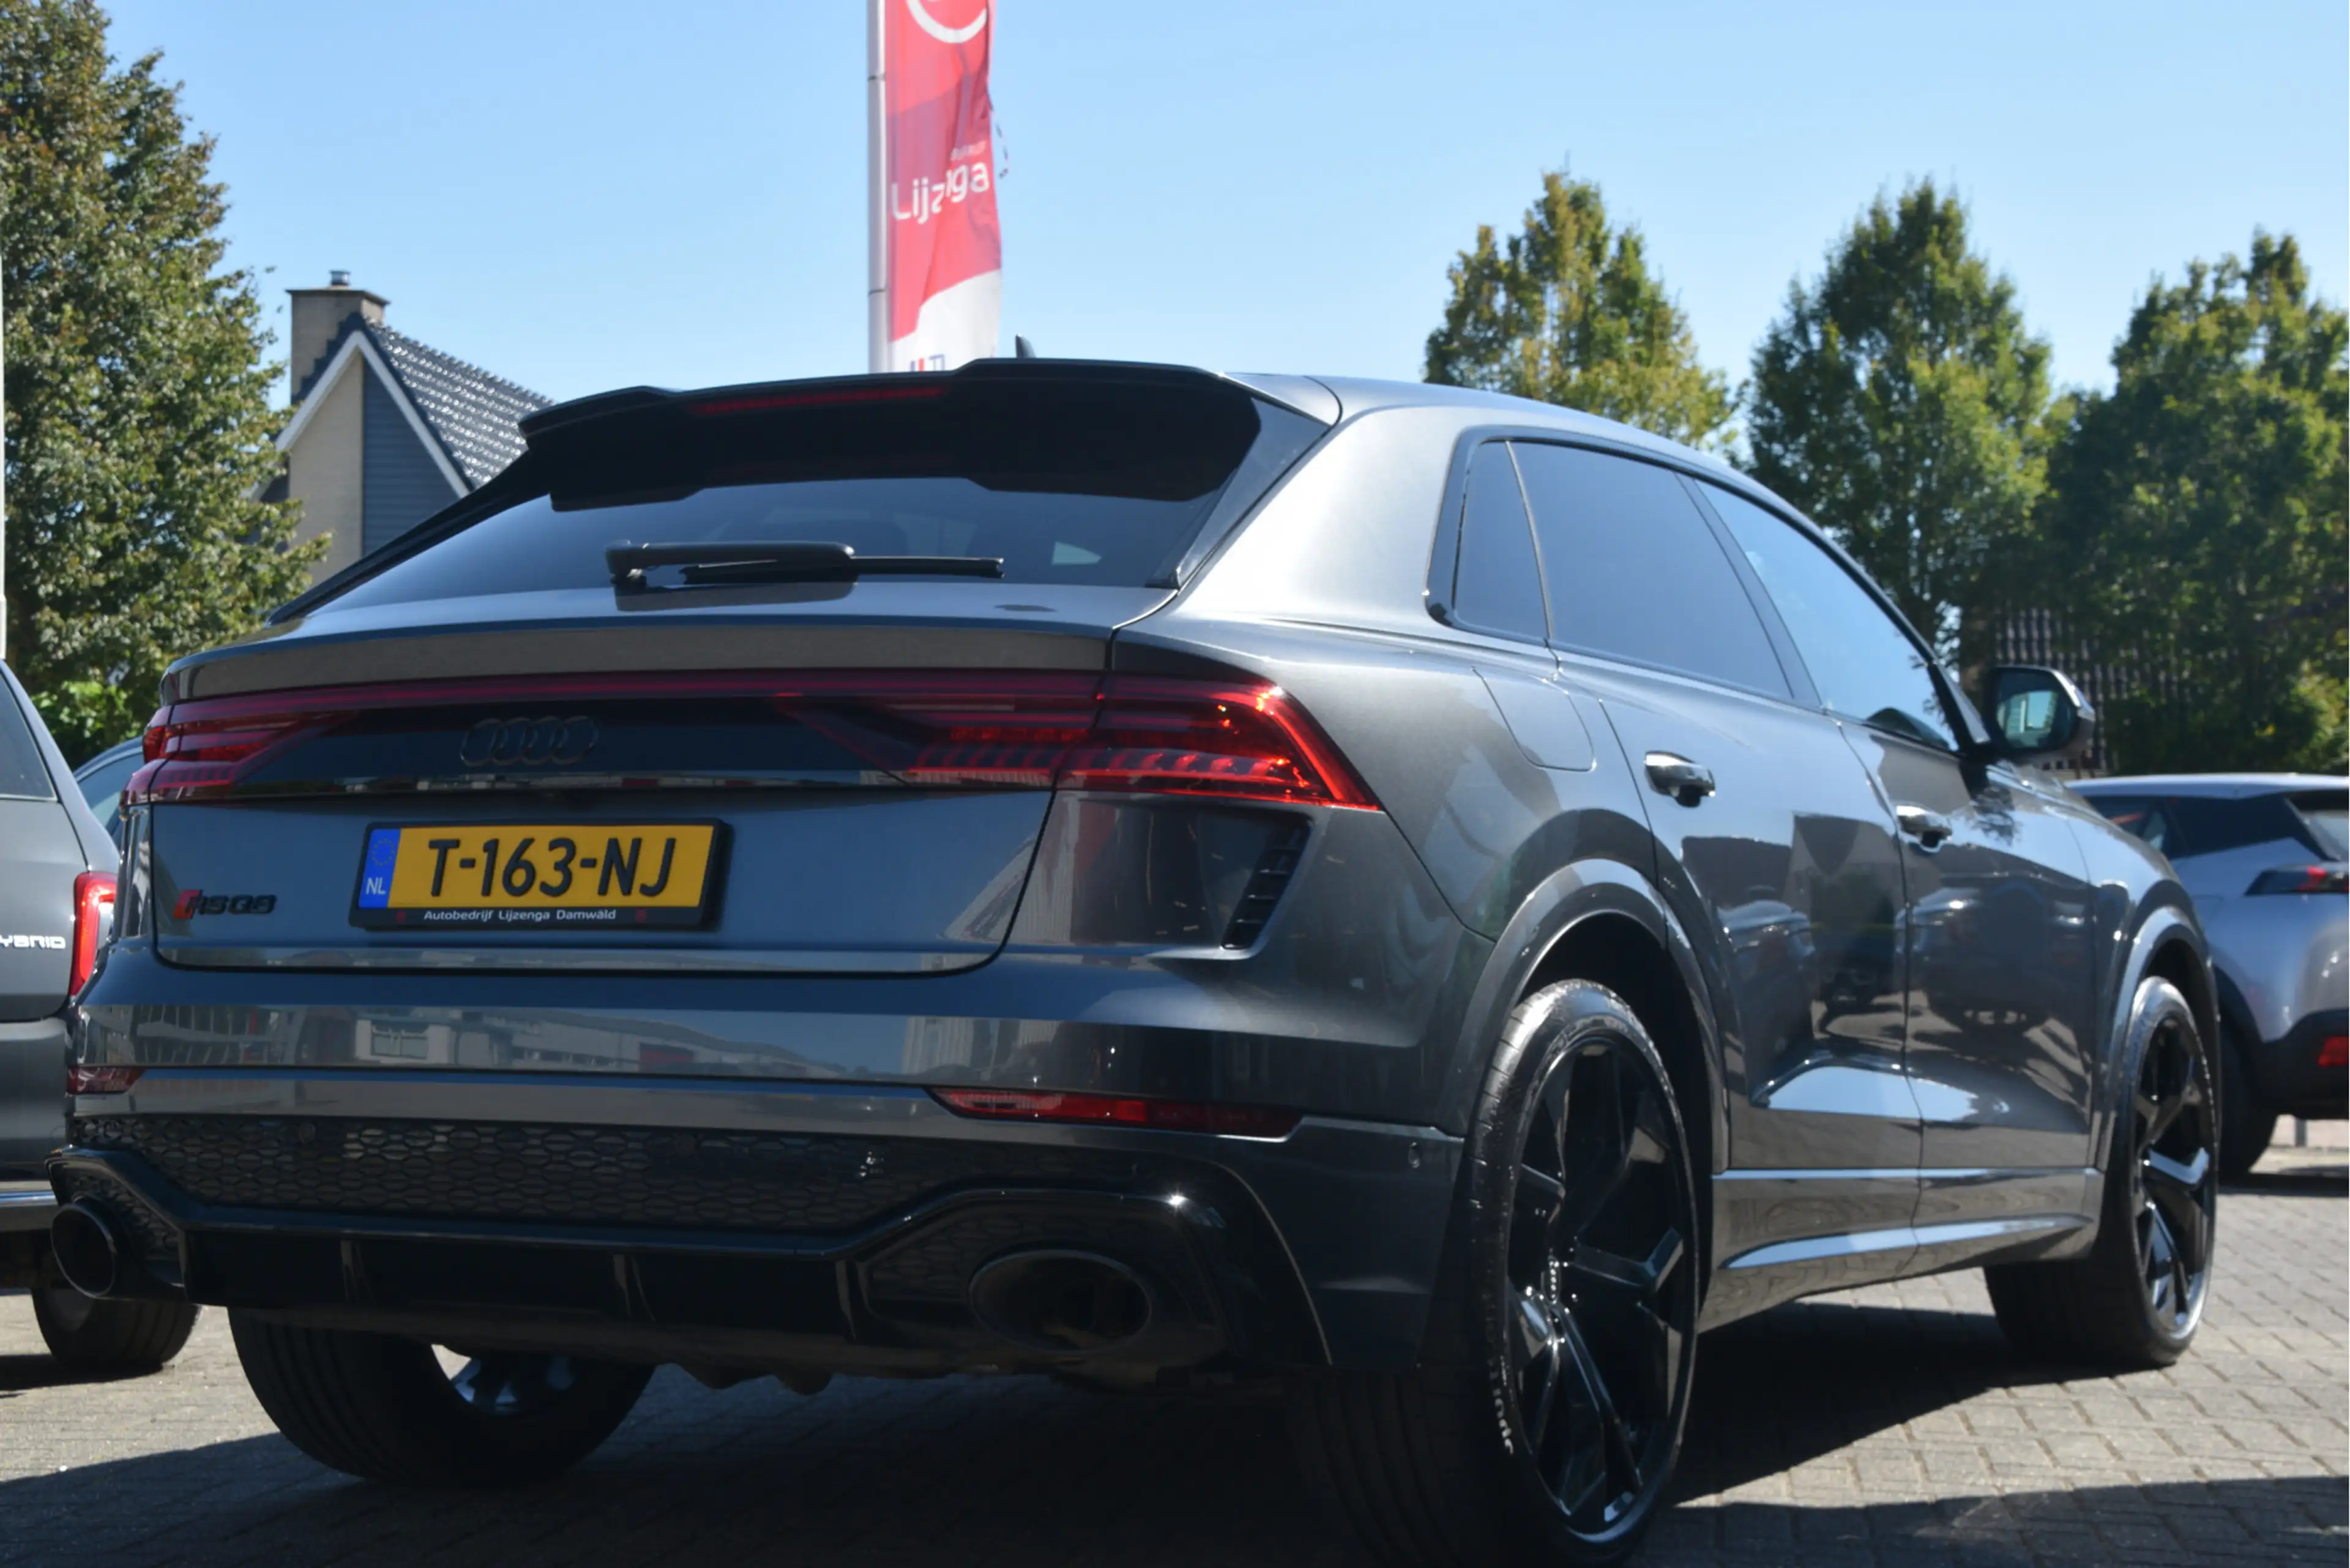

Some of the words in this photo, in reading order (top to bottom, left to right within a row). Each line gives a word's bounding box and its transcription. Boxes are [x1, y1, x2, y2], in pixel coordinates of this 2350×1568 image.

[428, 837, 676, 897] T-163-NJ
[365, 876, 386, 895] NL
[423, 909, 494, 922] Autobedrijf
[499, 909, 550, 922] Lijzenga
